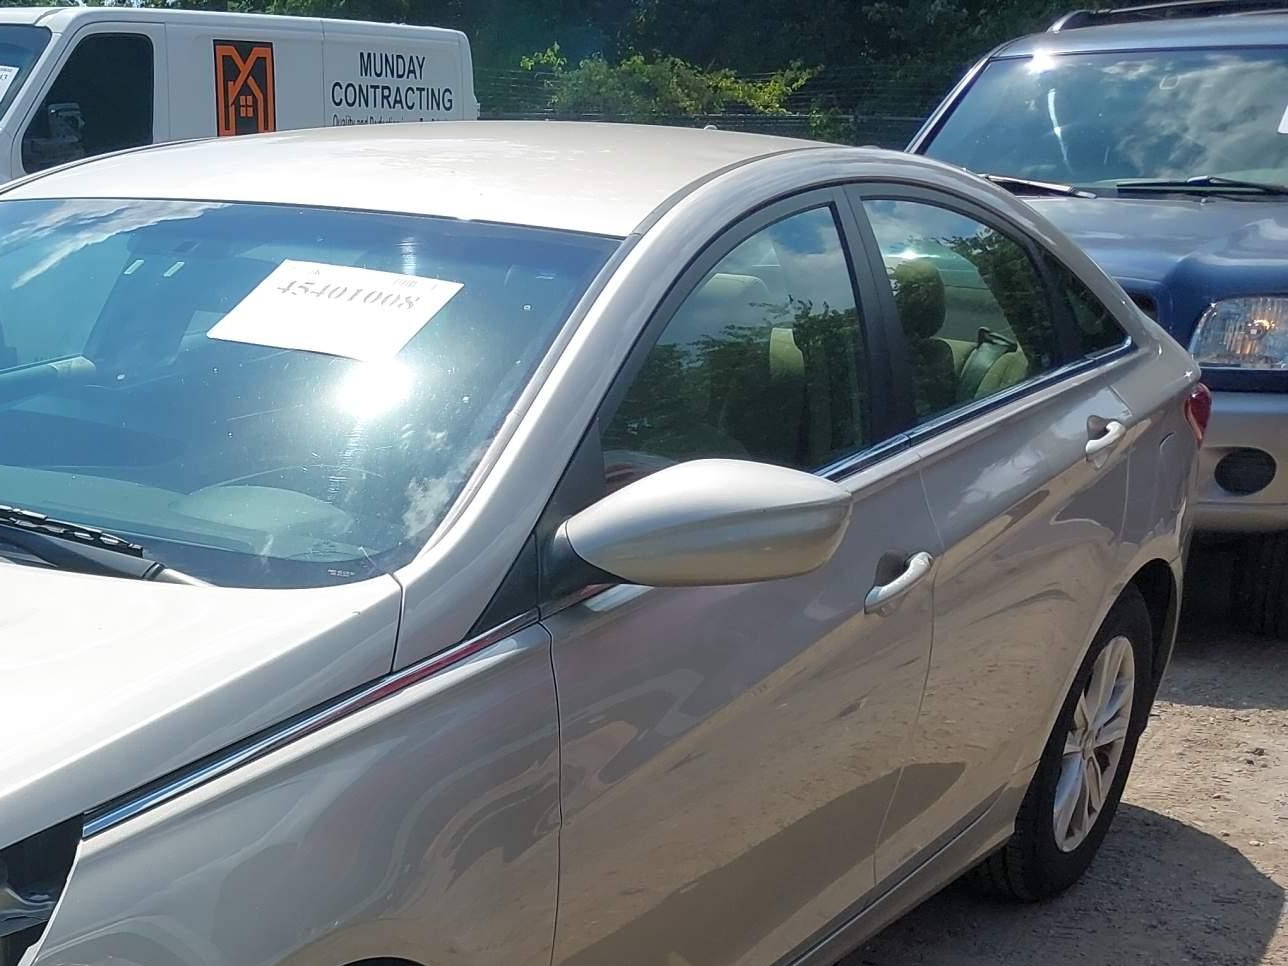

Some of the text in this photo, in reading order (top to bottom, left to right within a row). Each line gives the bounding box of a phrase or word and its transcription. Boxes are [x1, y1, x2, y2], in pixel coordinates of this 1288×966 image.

[359, 52, 426, 79] MUNDAY
[331, 81, 454, 111] CONTRACTING
[276, 280, 421, 309] 45401008
